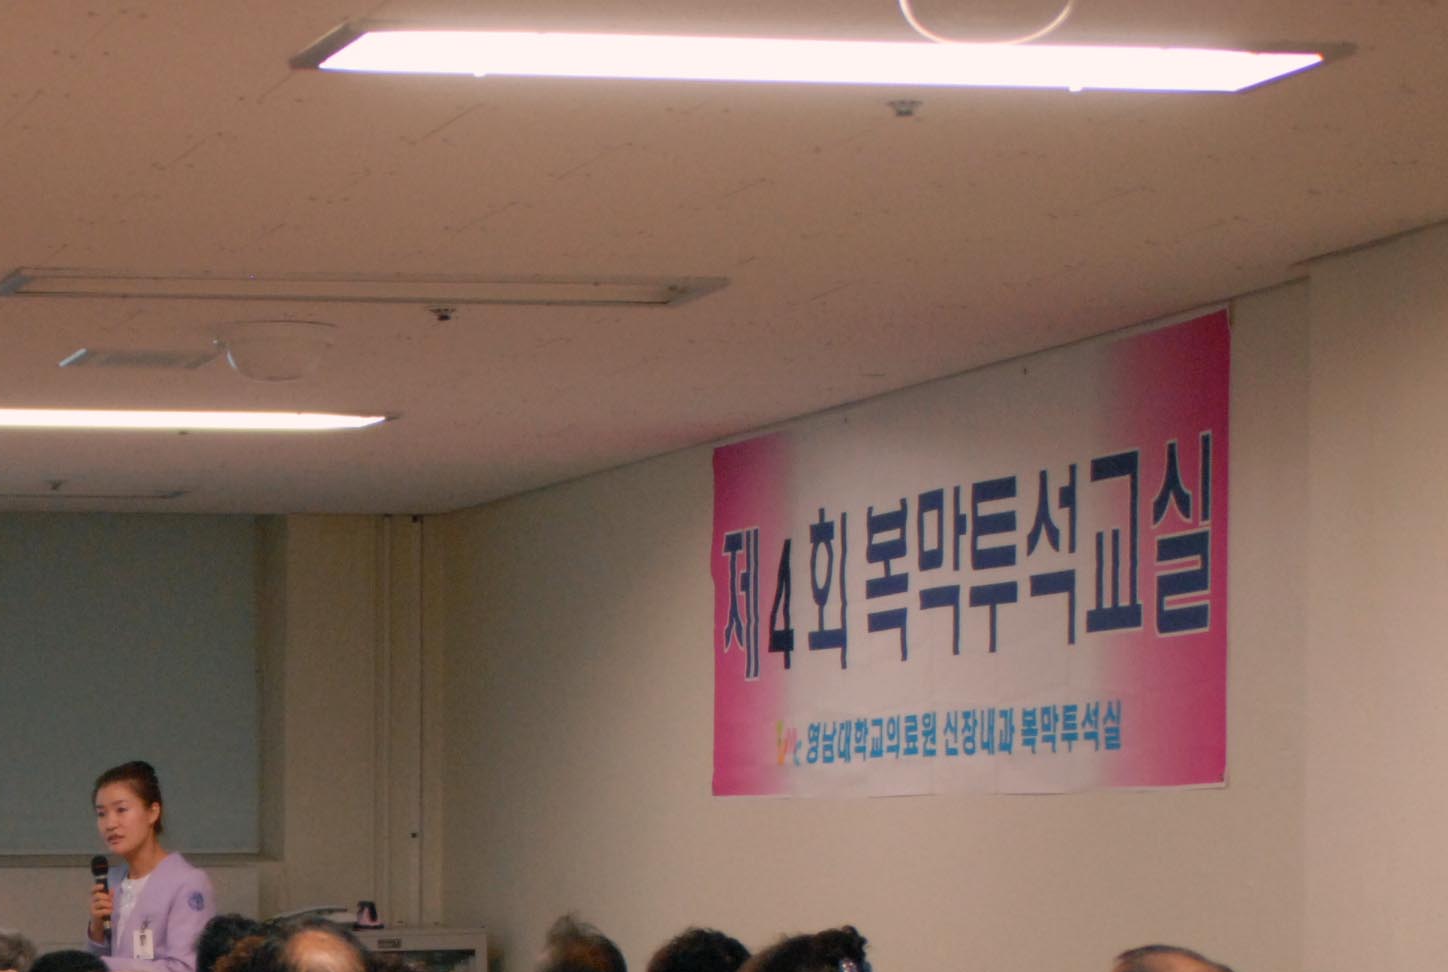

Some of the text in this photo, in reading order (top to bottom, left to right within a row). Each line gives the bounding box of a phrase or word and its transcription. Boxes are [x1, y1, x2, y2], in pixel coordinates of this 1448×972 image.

[806, 700, 1123, 764] 영남대학교의료원 신장내과 복막투석실
